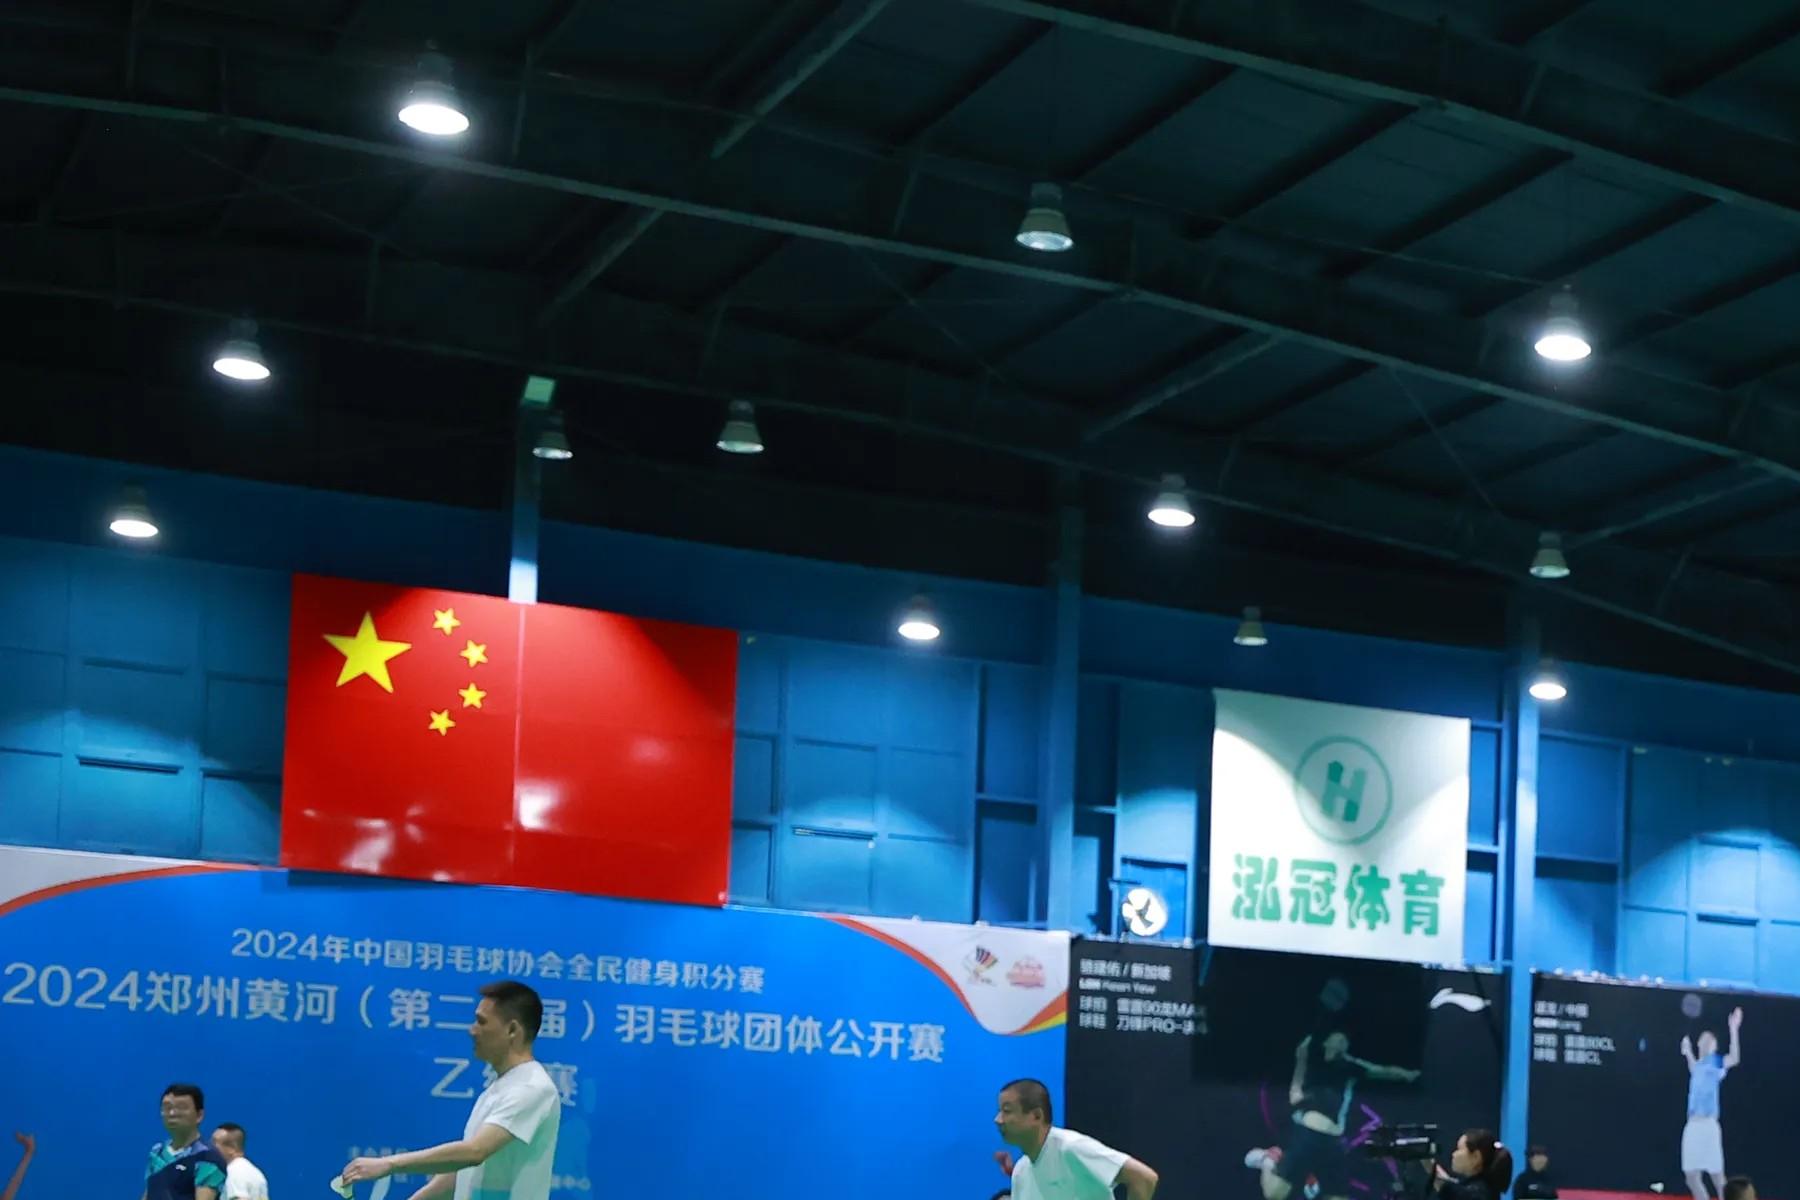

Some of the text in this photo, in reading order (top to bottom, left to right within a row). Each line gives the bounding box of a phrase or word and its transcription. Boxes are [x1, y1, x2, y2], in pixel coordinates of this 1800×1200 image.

[1232, 853, 1445, 936] 泓冠体育
[231, 927, 766, 994] 2024年中国羽毛球协会全民健身积分赛
